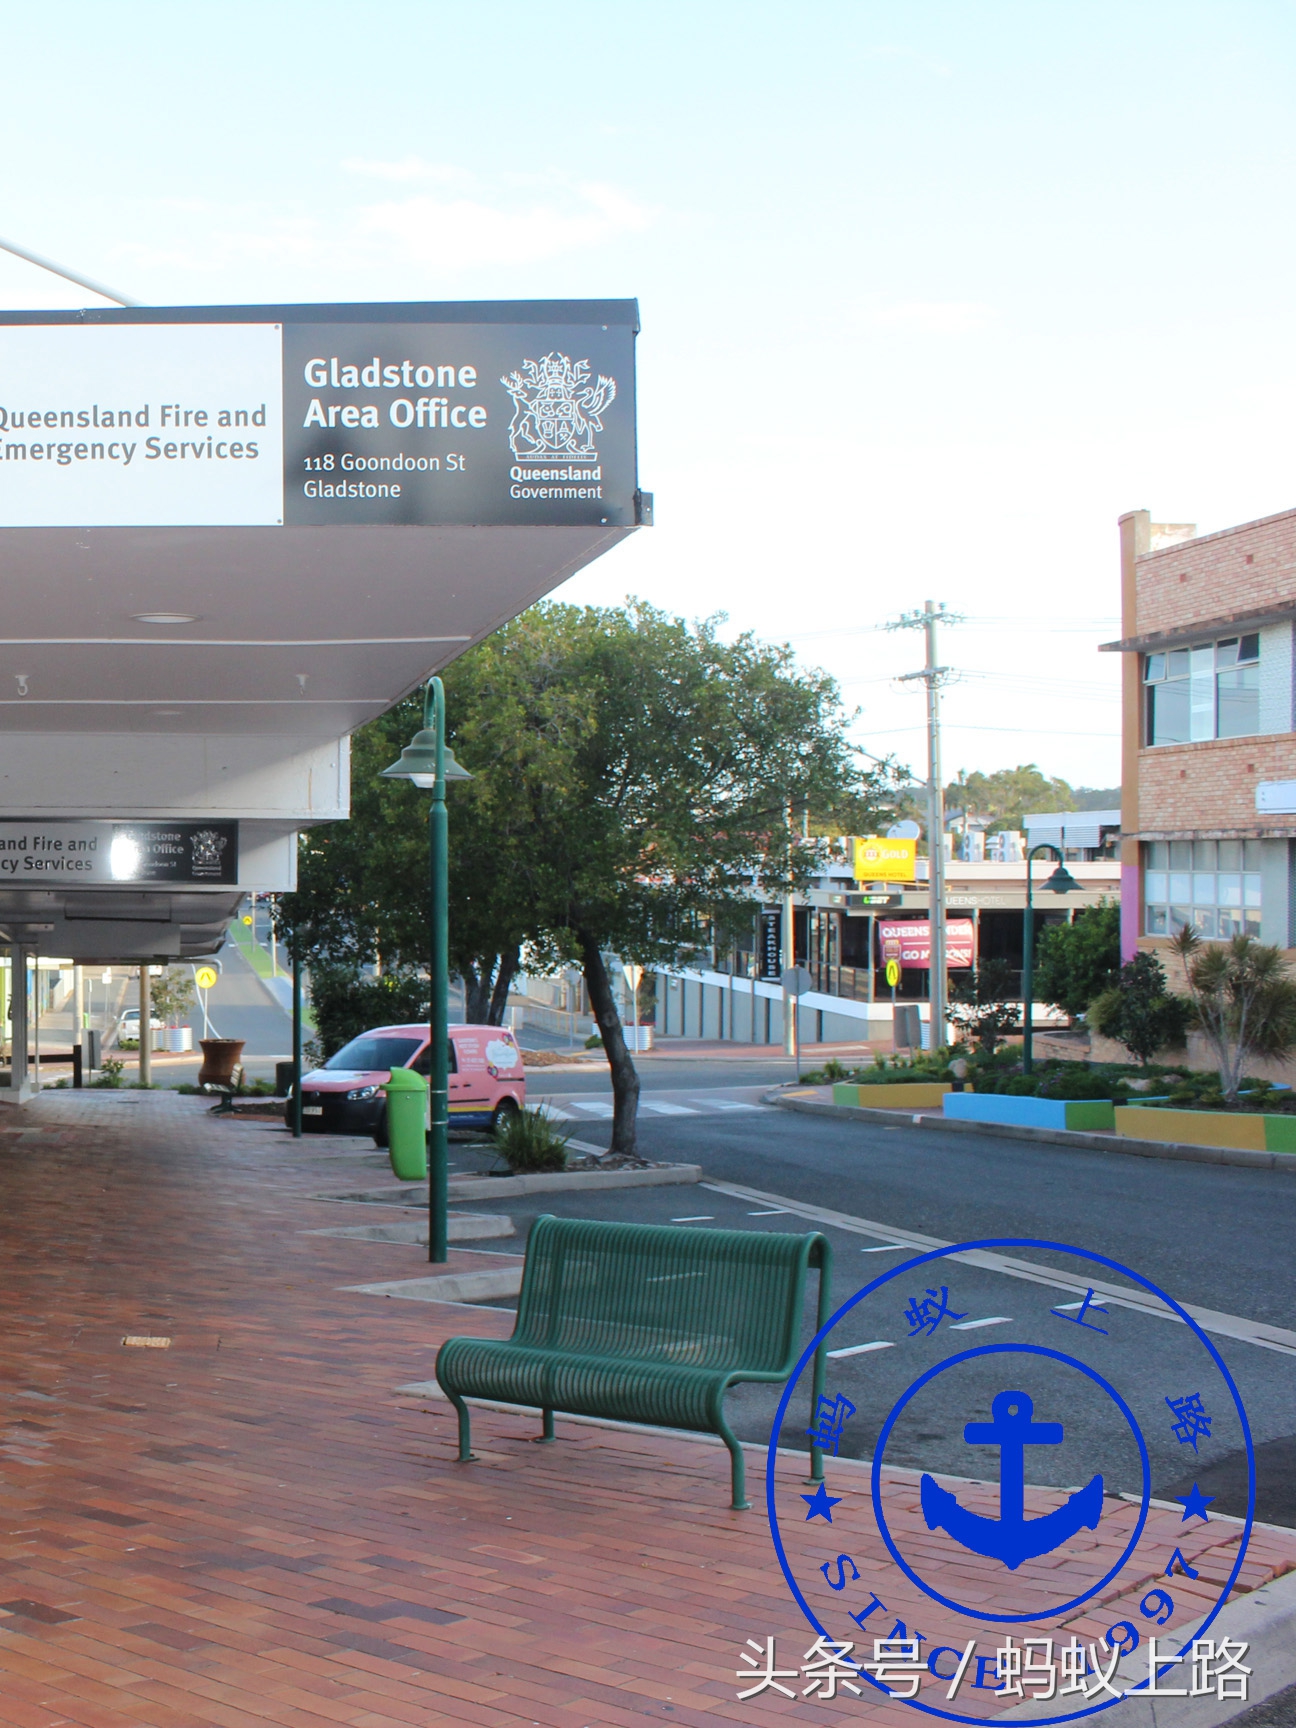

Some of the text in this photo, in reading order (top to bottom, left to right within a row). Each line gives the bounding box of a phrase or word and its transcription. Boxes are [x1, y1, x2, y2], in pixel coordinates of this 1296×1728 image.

[304, 357, 477, 388] Gladstone
[160, 403, 208, 427] Fire
[217, 403, 267, 427] and
[304, 397, 487, 428] Area Office
[145, 436, 259, 460] Services
[304, 453, 465, 471] 118 Goondoon St
[509, 465, 601, 482] Queensland
[303, 480, 401, 498] Gladstone
[509, 484, 603, 499] Government
[33, 836, 63, 851] Fire
[68, 837, 98, 851] and
[153, 843, 184, 854] Office
[881, 849, 909, 860] GOLD
[23, 856, 93, 871] Services
[766, 915, 777, 976] STEAKHOUSE
[902, 949, 920, 960] GO
